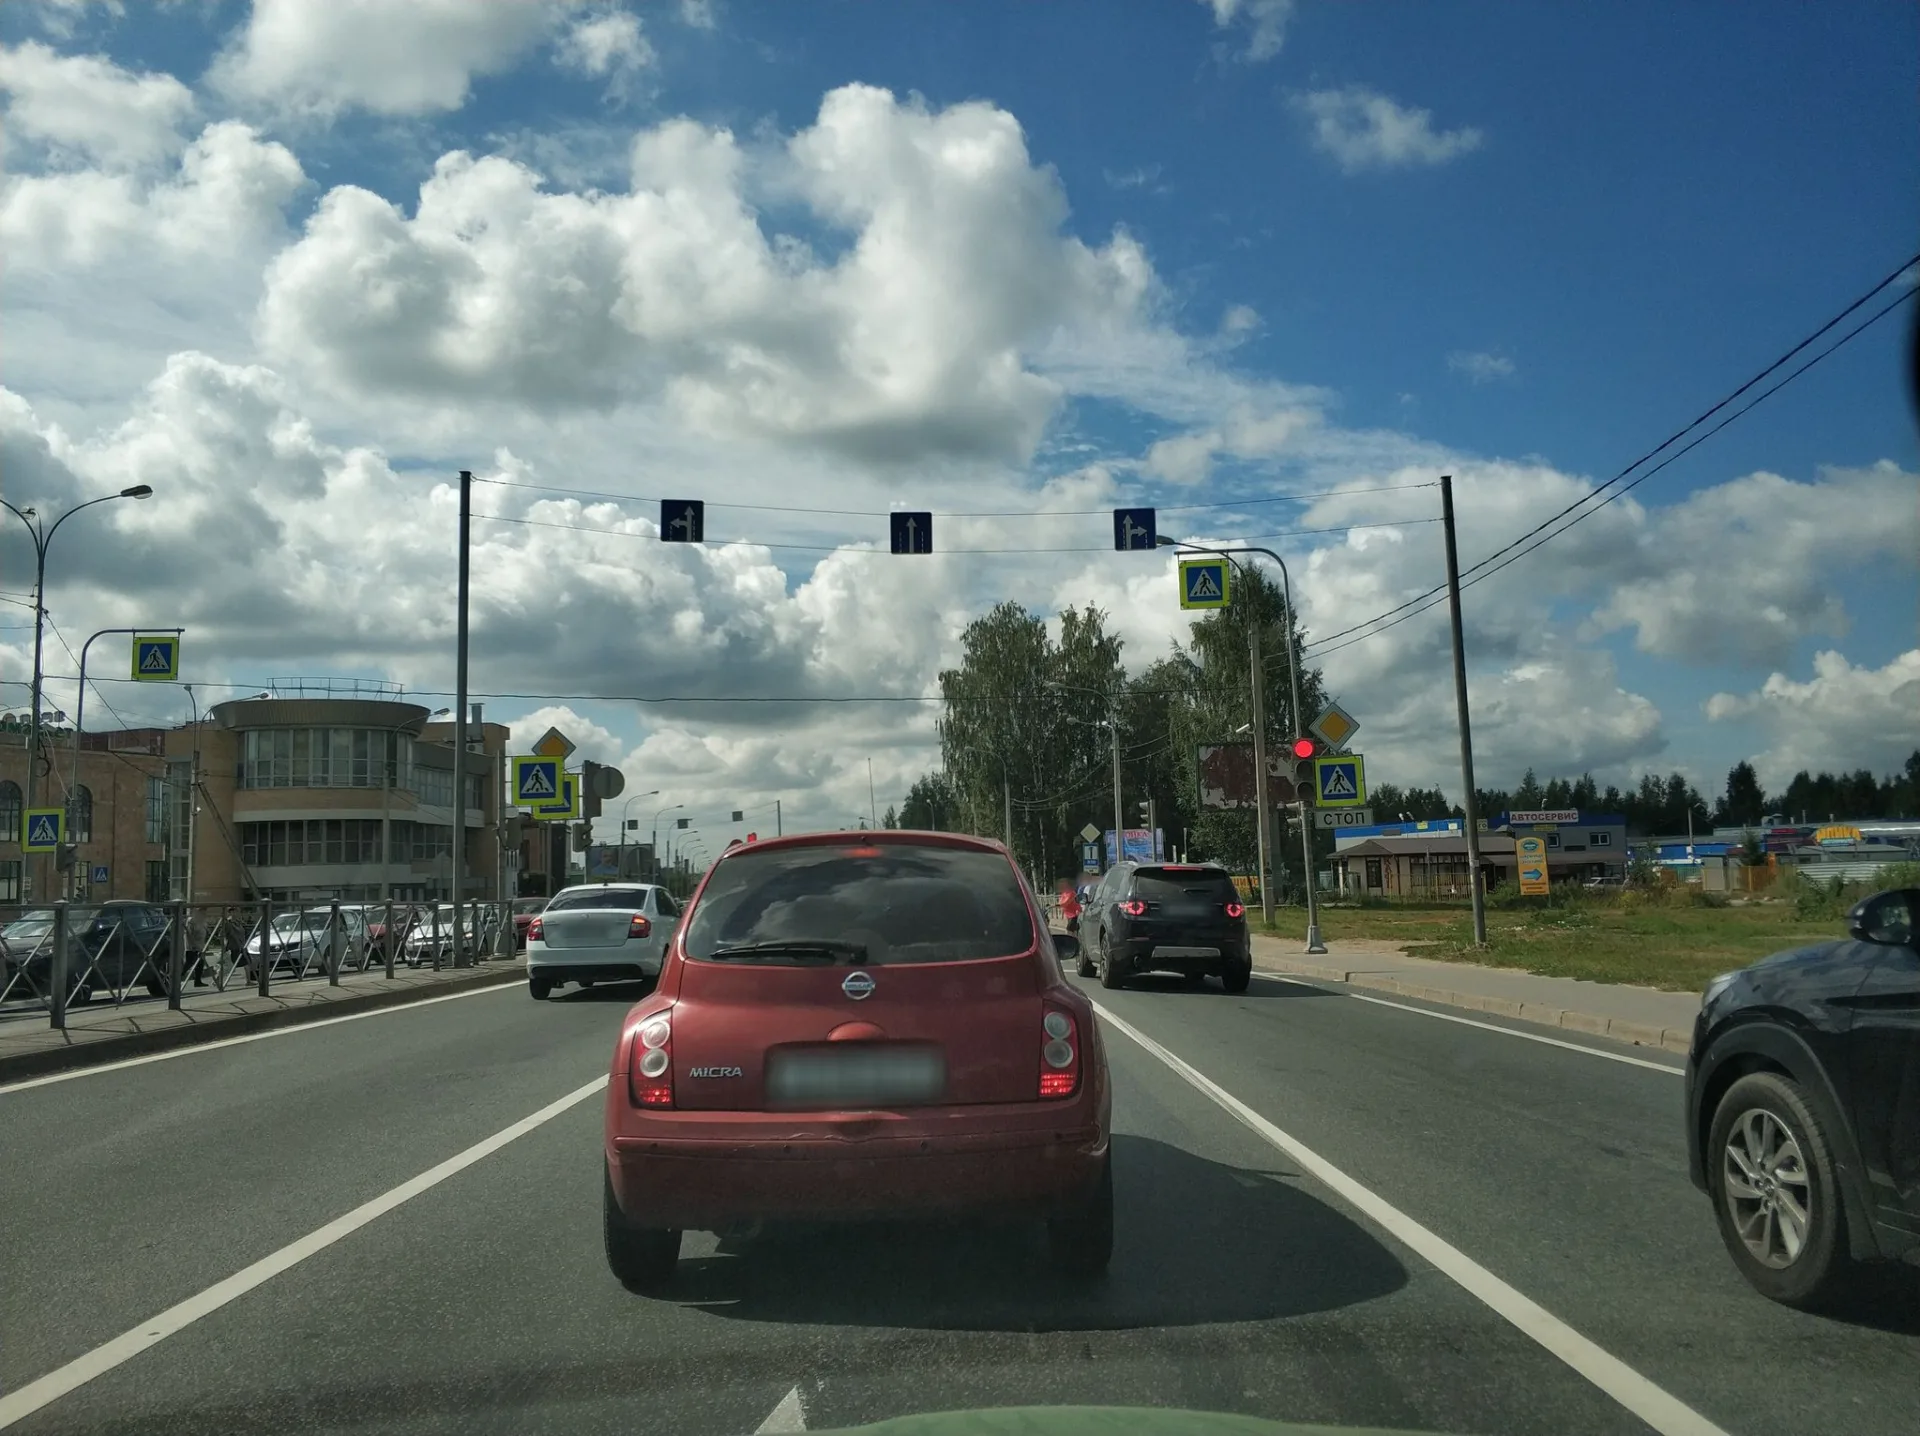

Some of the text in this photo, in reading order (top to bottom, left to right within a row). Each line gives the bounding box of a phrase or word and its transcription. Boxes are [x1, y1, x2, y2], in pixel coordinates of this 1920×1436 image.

[1323, 812, 1365, 825] СТОП
[1510, 812, 1578, 822] АВТОСЕРВИС
[688, 1066, 743, 1078] MICRA
